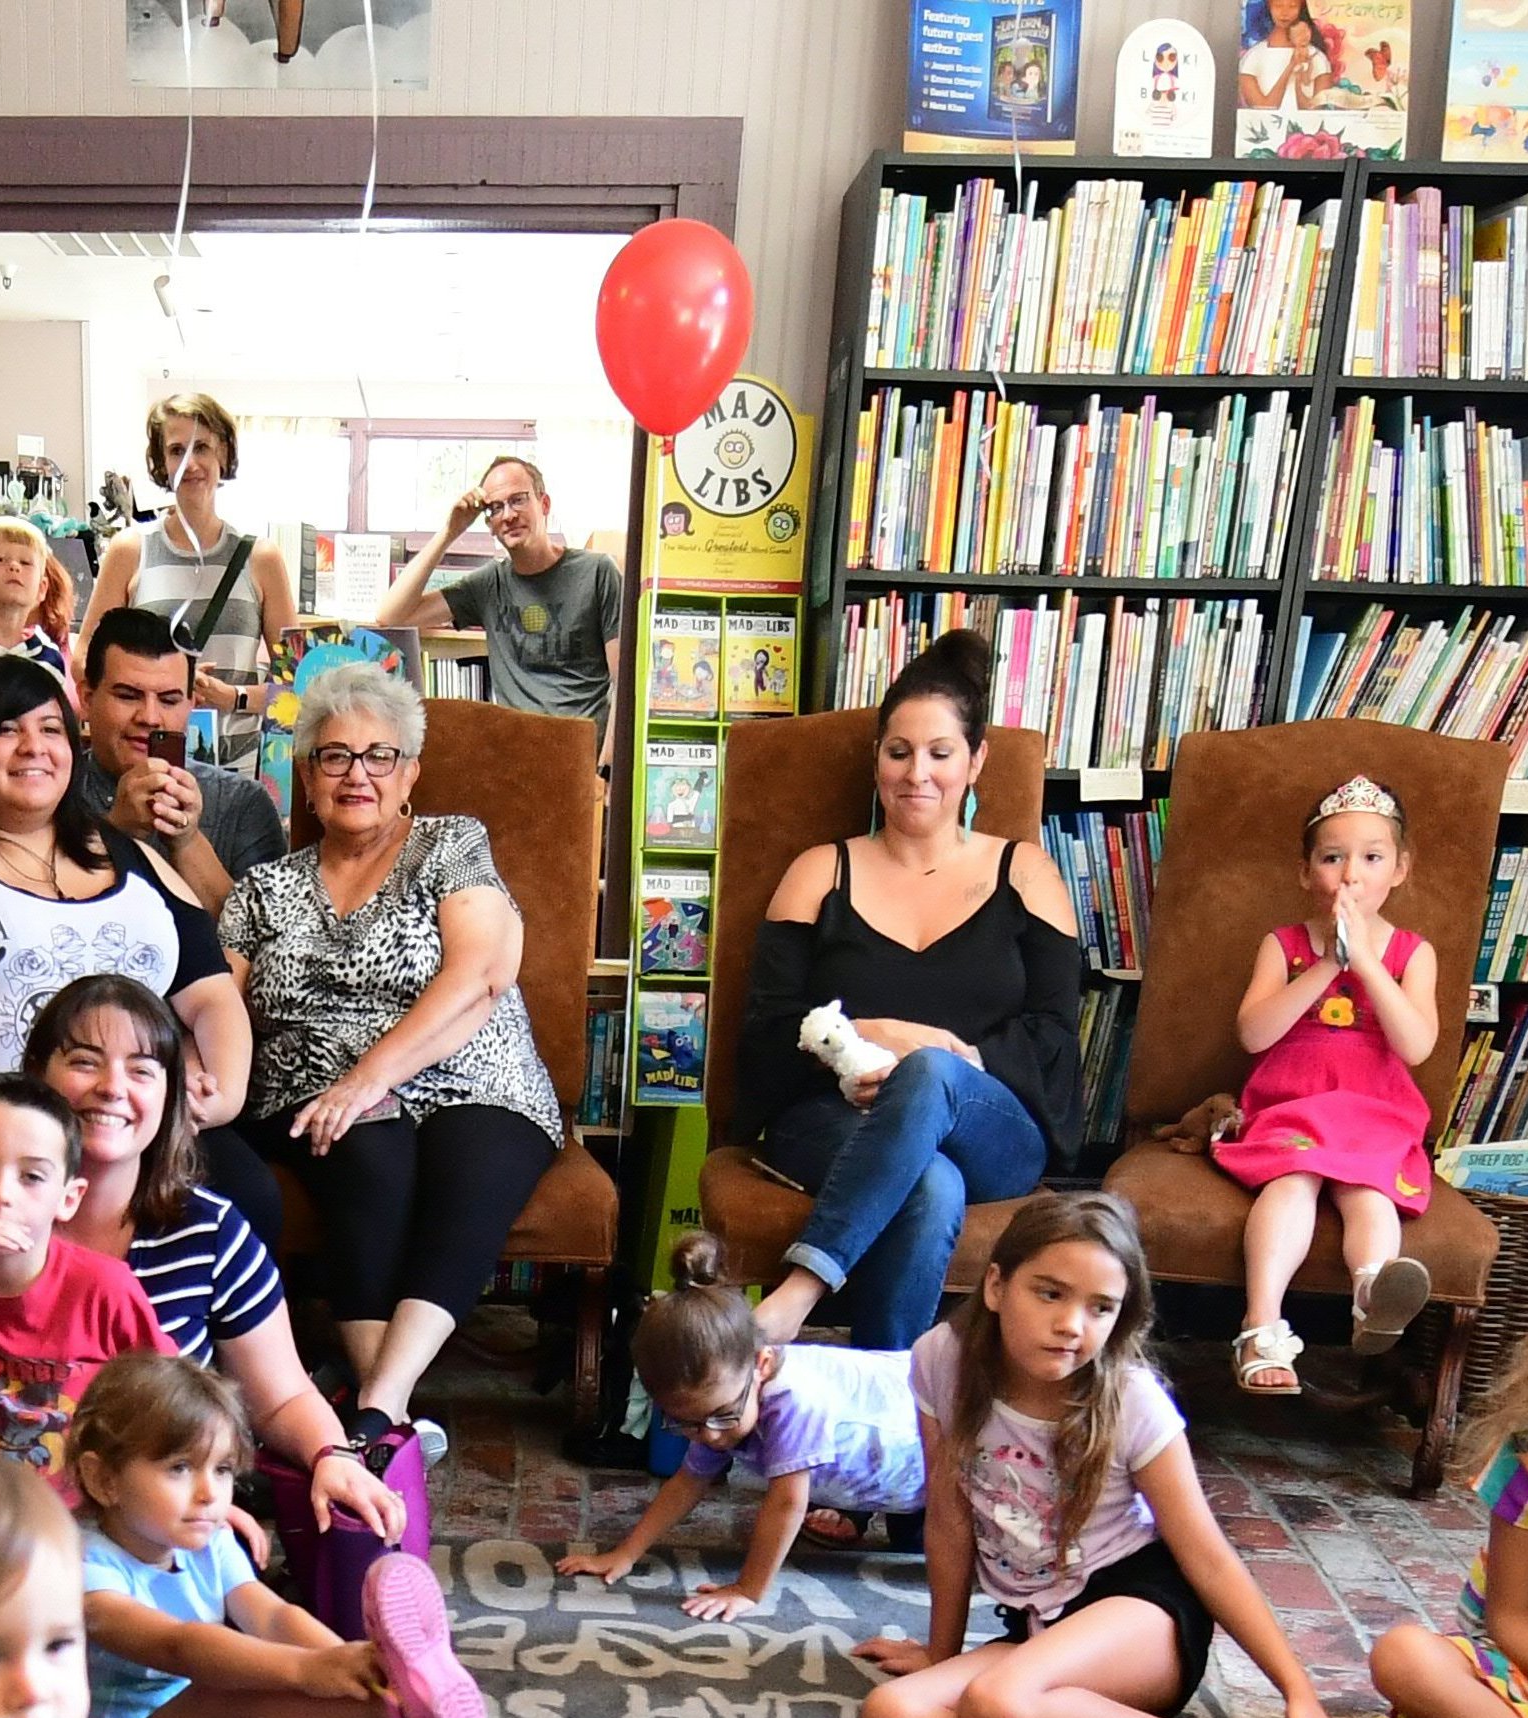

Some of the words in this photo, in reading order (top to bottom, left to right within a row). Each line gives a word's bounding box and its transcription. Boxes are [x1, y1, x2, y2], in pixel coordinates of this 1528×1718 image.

[923, 9, 970, 28] Featuring
[922, 25, 954, 40] future
[704, 390, 776, 429] MAD
[694, 468, 772, 507] LIBS
[654, 617, 678, 629] MAD
[692, 619, 715, 631] LIBS
[728, 619, 752, 630] MAD
[767, 620, 790, 632] LIBS
[650, 747, 674, 757] MAD
[689, 748, 712, 758] LIBS
[646, 878, 671, 890] MAD
[685, 879, 708, 891] LIBS
[1468, 1154, 1500, 1167] SHEEP
[1502, 1154, 1523, 1167] DOG
